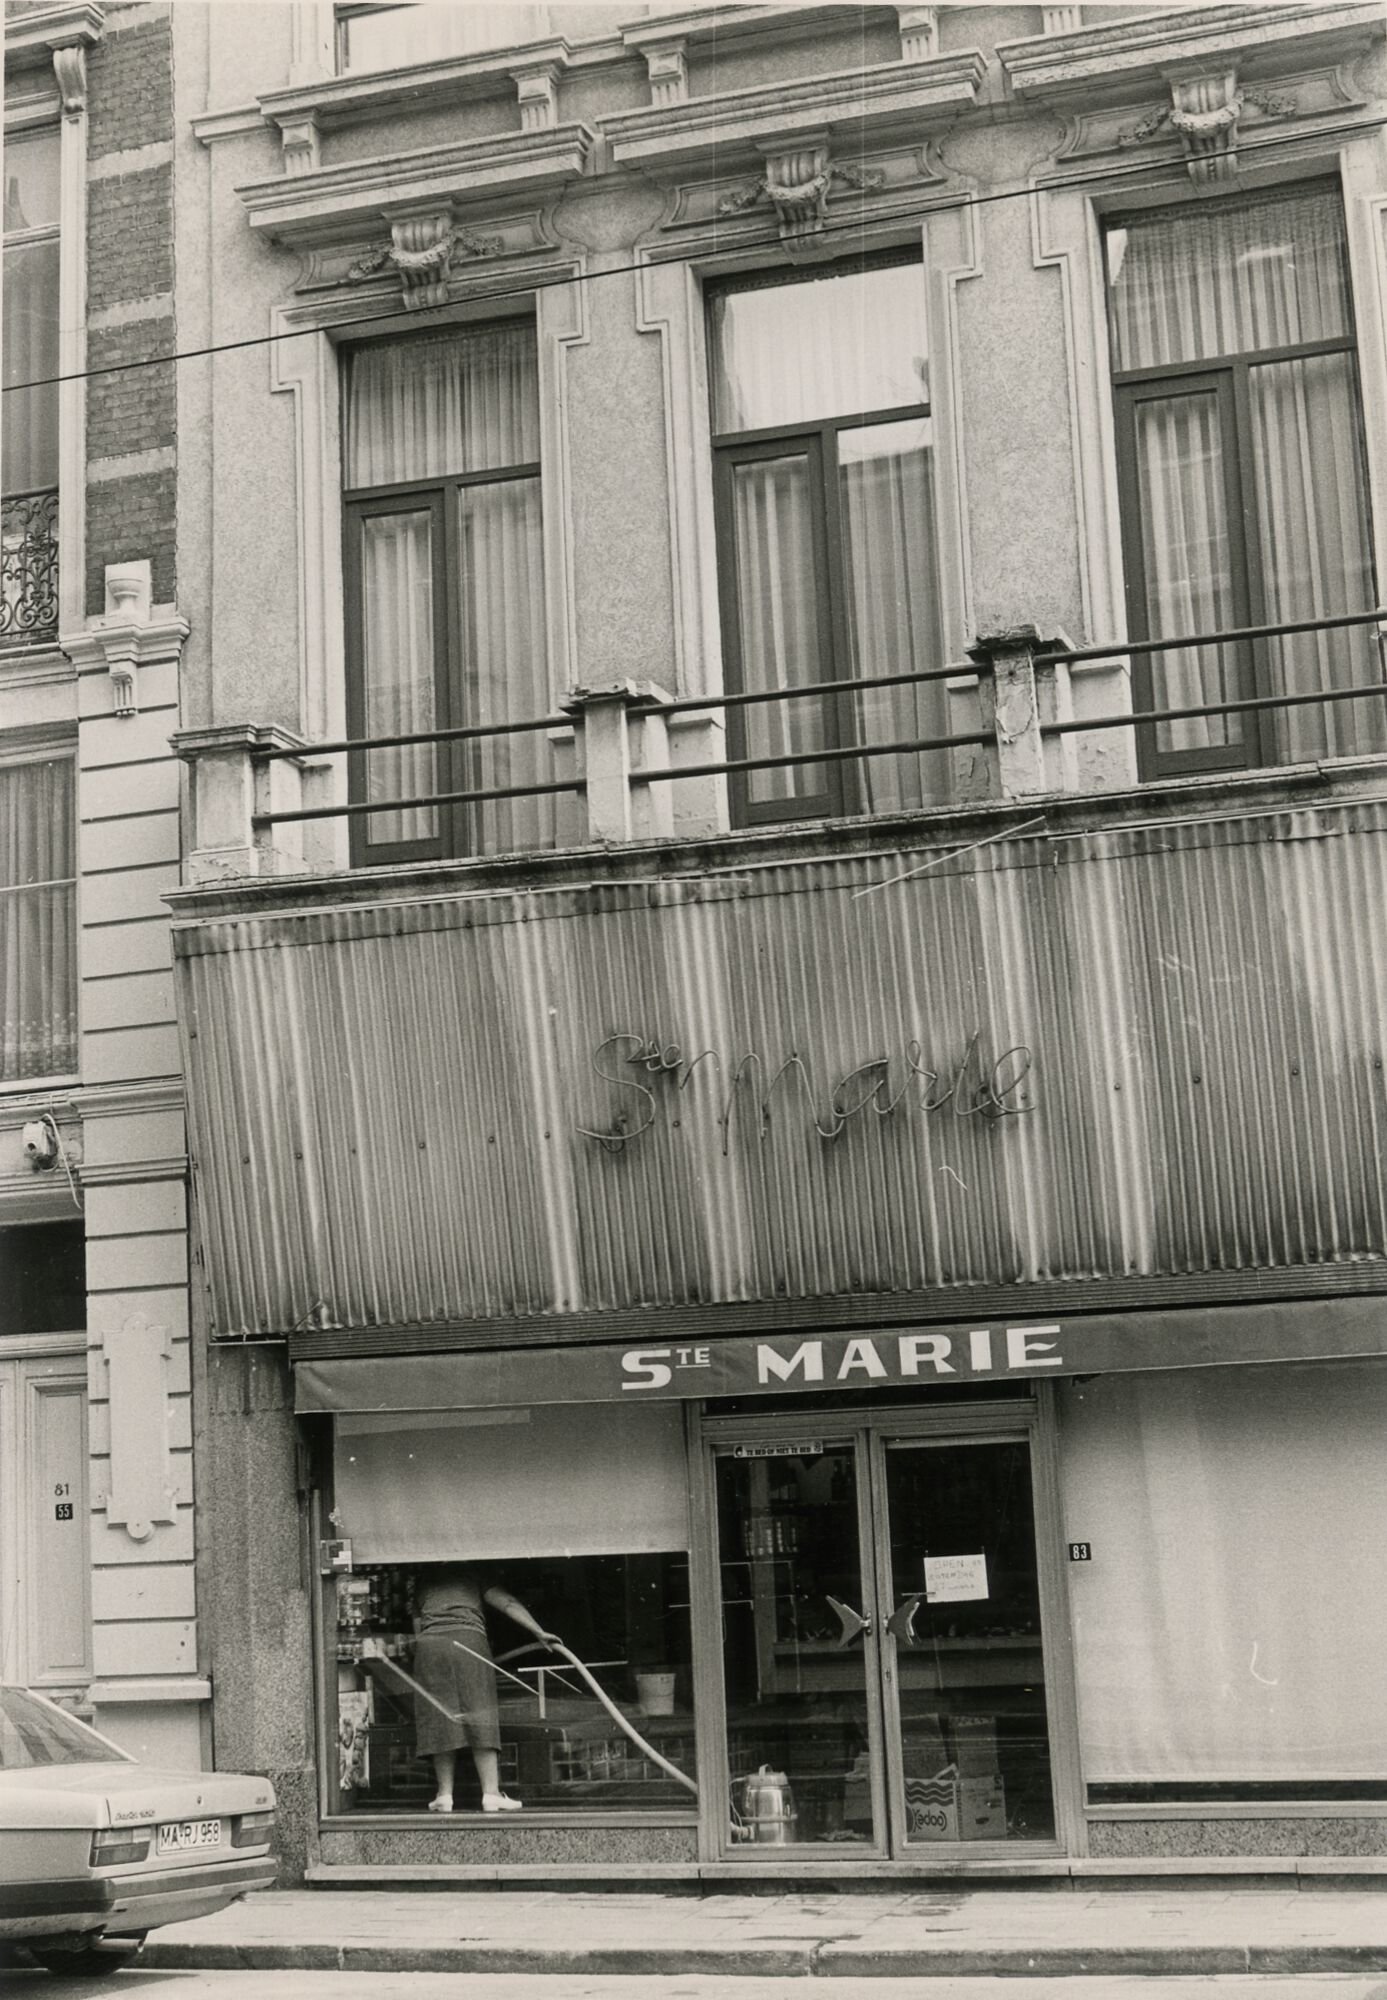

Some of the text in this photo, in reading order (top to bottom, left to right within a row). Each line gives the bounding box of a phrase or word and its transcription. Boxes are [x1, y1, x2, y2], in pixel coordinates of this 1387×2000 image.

[757, 1325, 1064, 1384] MARIE
[54, 1483, 69, 1496] 81
[58, 1505, 70, 1518] 55
[1072, 1544, 1087, 1560] 83
[201, 1822, 219, 1842] 958
